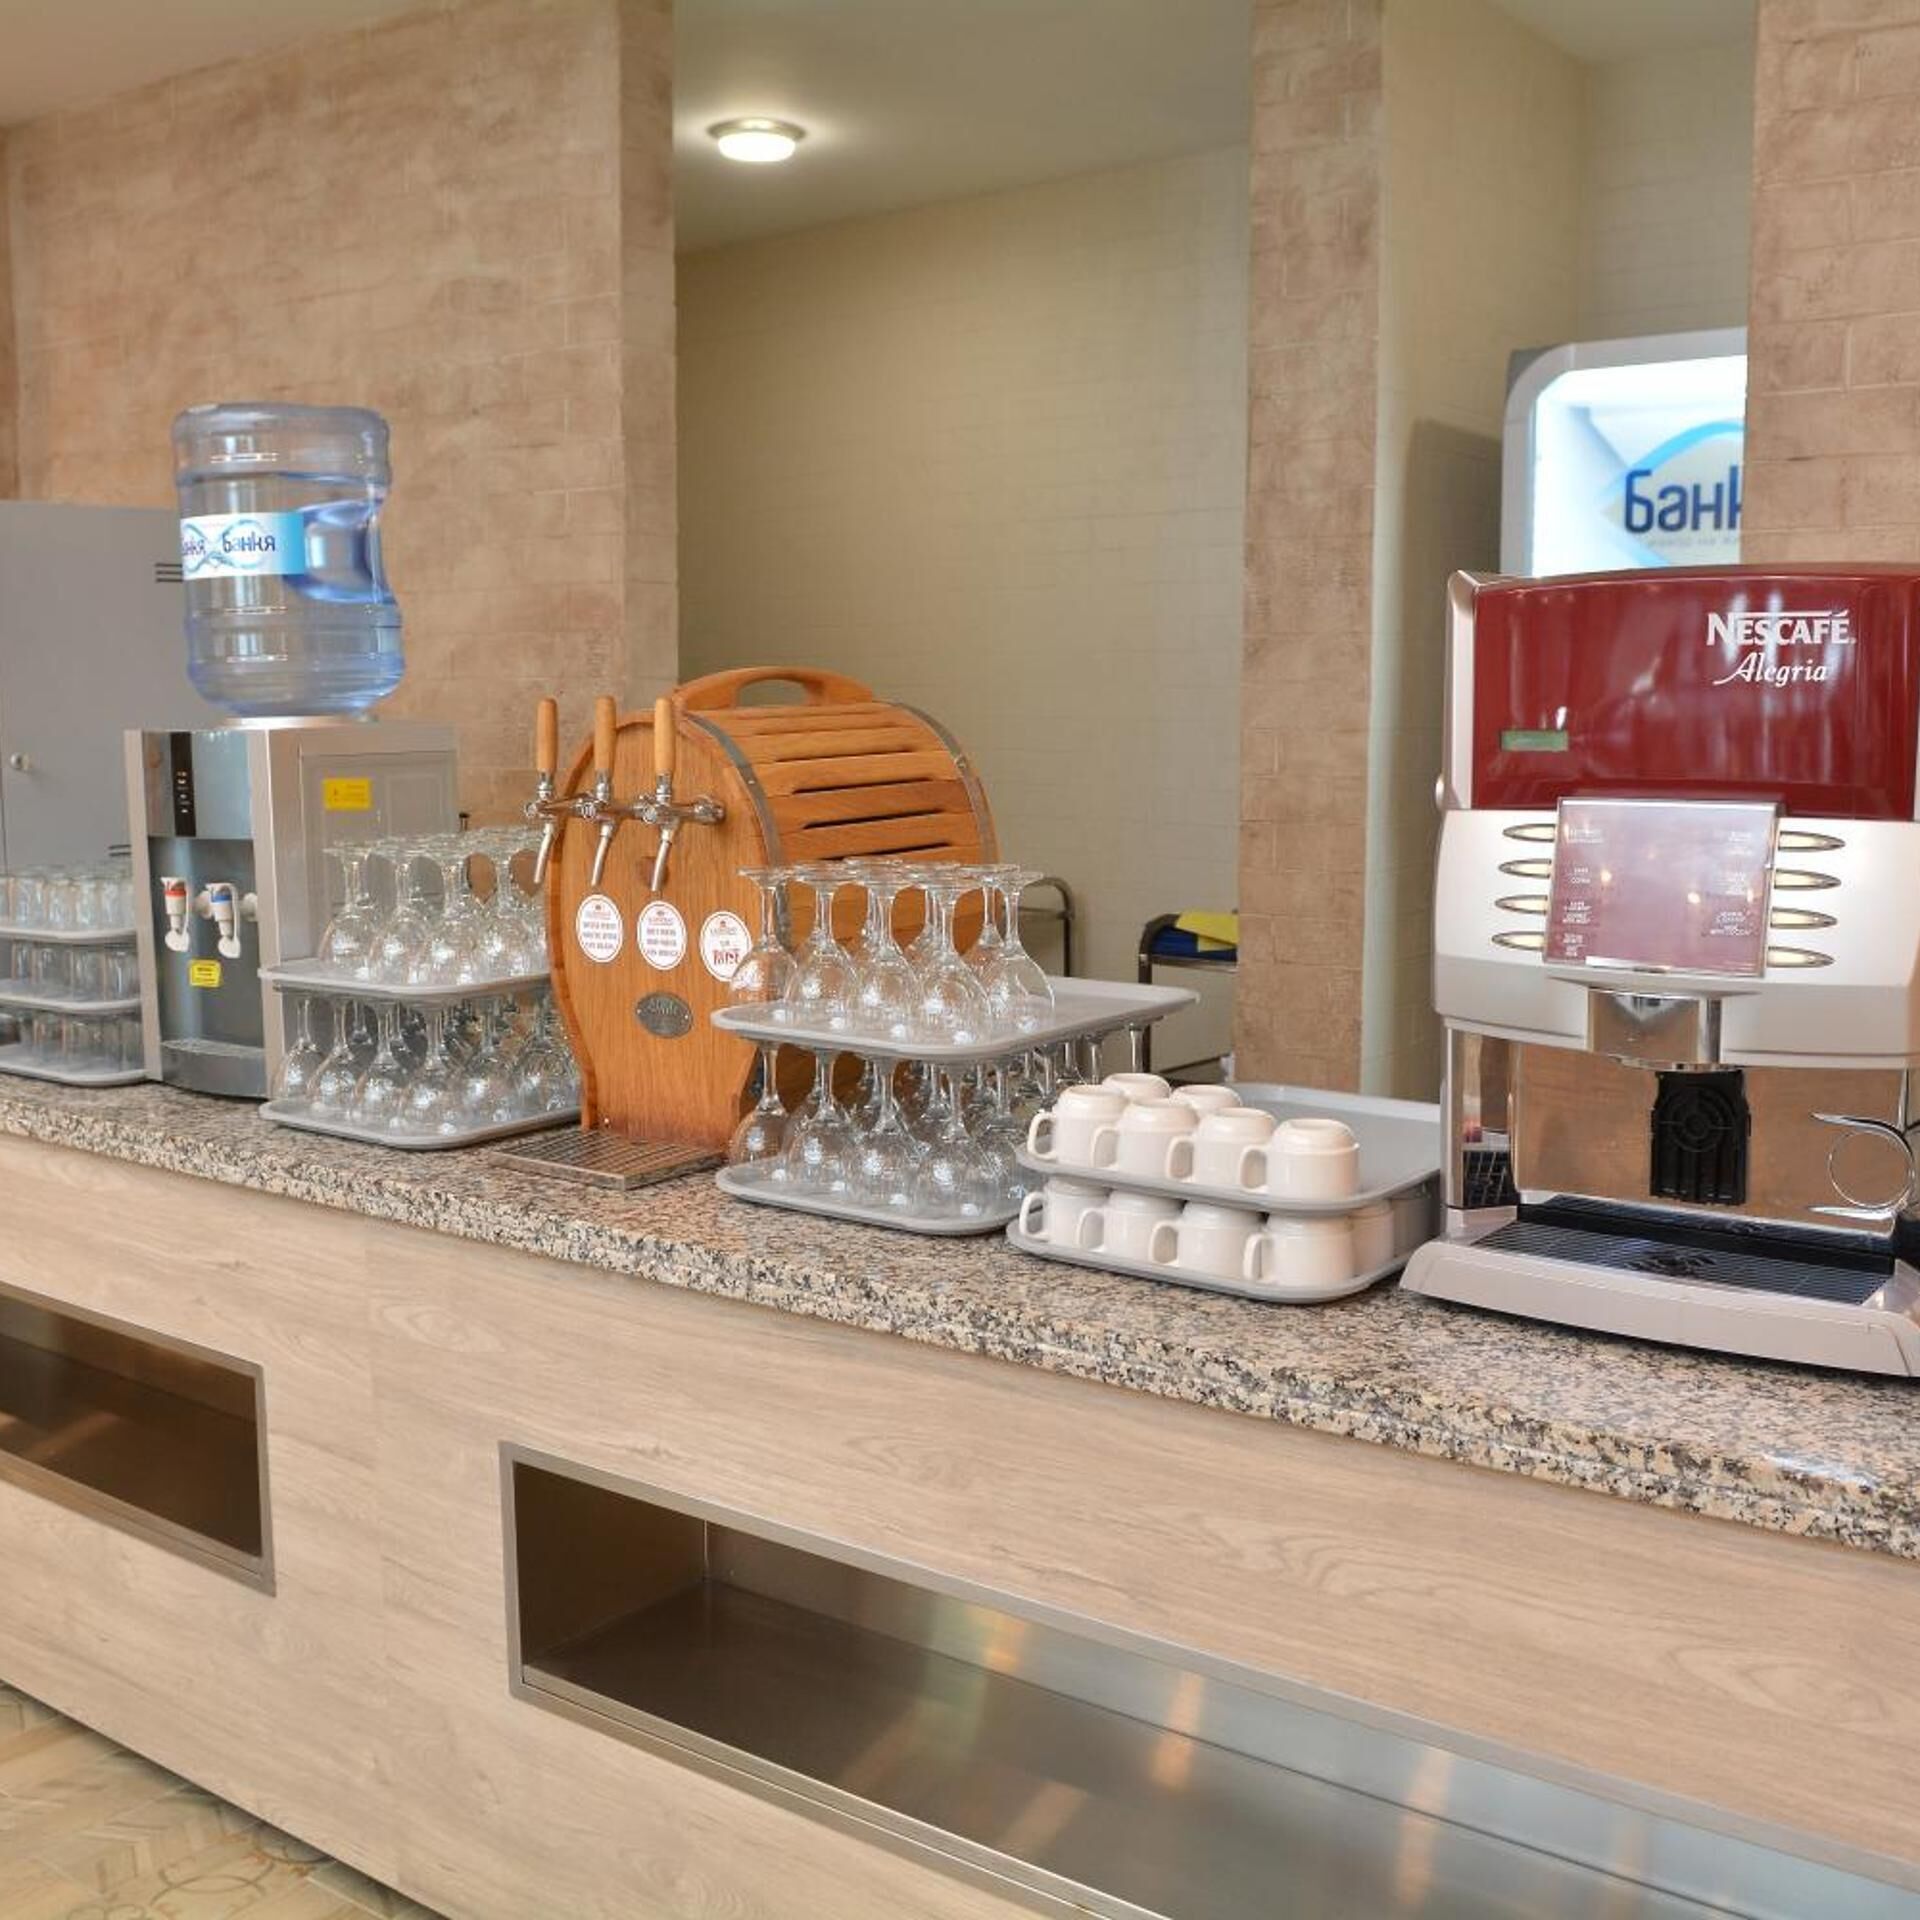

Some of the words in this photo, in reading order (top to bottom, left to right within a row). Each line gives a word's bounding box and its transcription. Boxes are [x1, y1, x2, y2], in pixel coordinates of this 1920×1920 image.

[222, 531, 276, 553] Банкя
[1706, 610, 1851, 646] NESCAFÉ
[1713, 651, 1827, 688] Alegria
